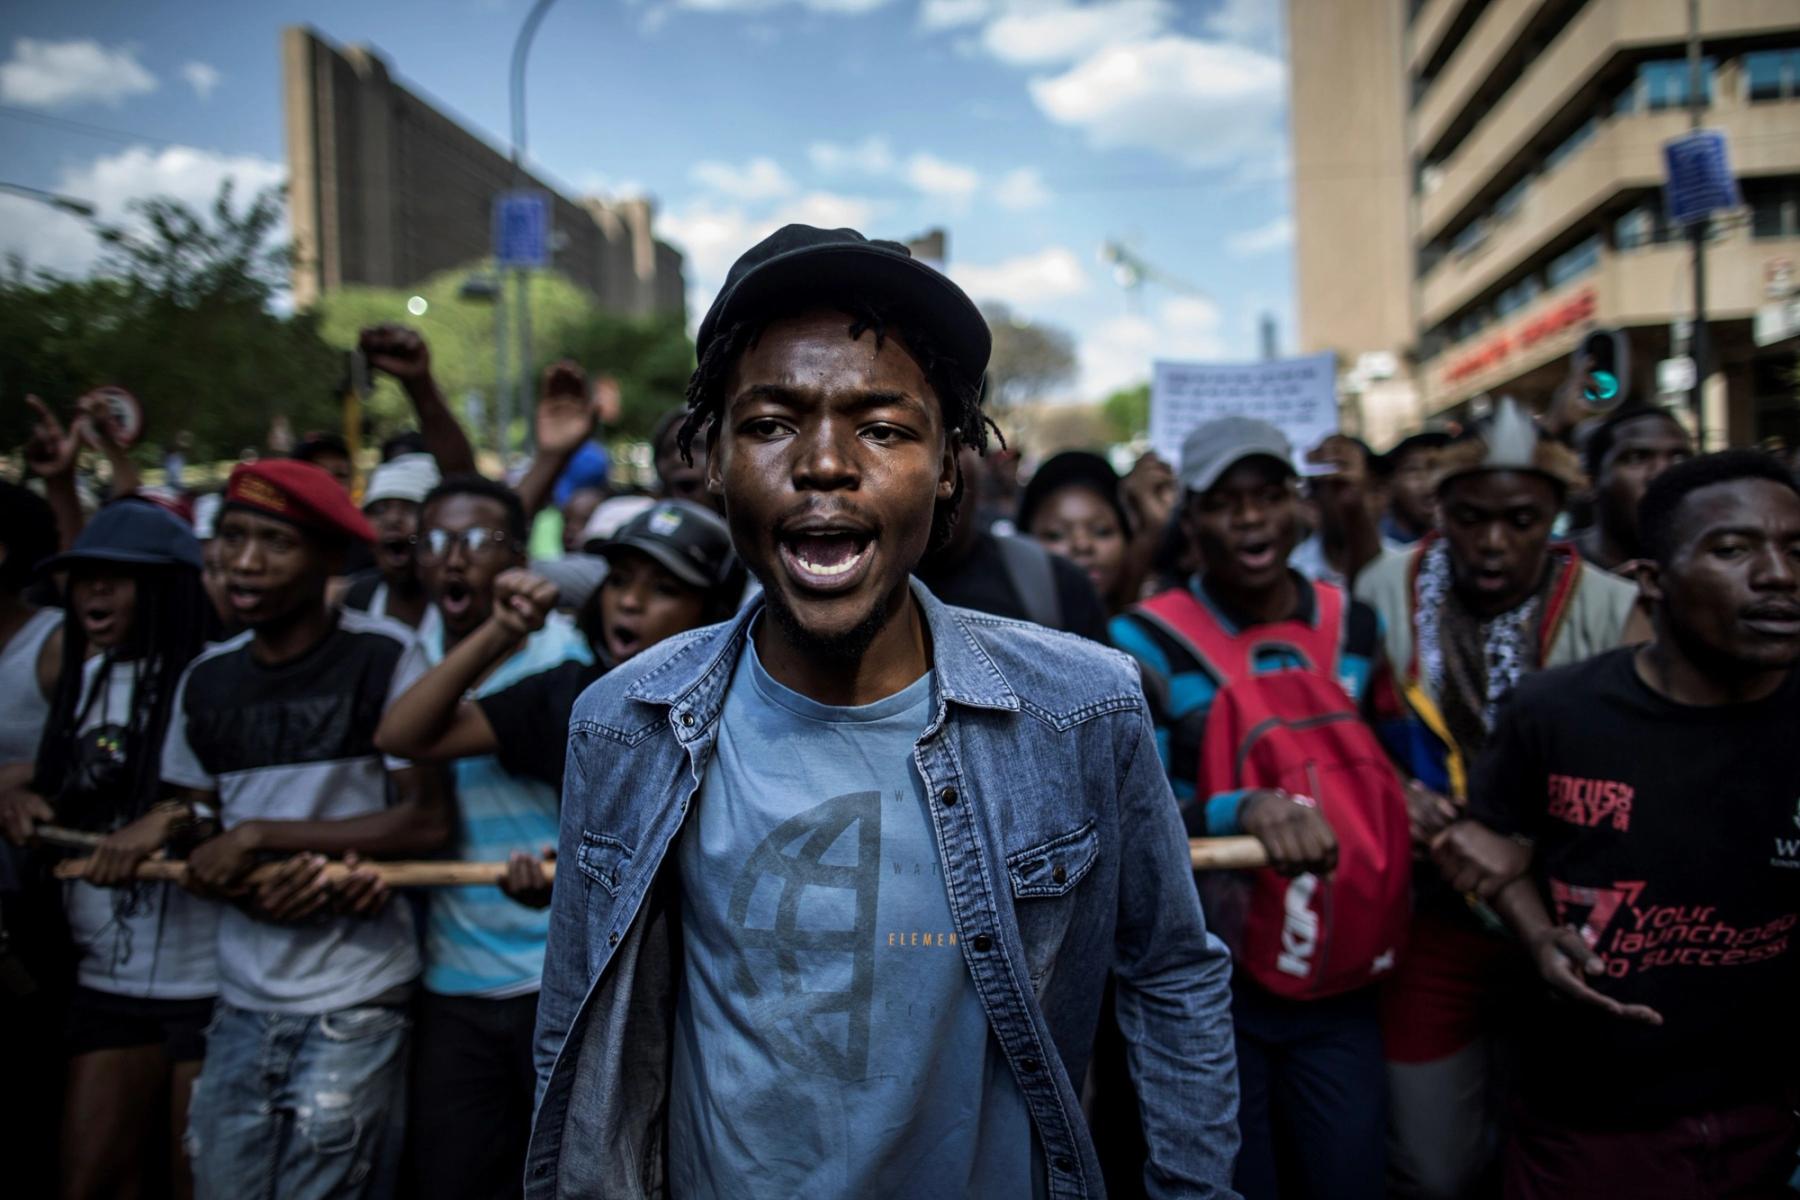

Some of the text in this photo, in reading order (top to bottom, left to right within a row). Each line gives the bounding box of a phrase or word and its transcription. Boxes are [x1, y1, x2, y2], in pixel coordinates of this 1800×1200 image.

[1547, 773, 1617, 808] FOCUS
[1548, 800, 1612, 827] DAY
[893, 863, 938, 875] WAT
[888, 932, 958, 947] ELEMEN
